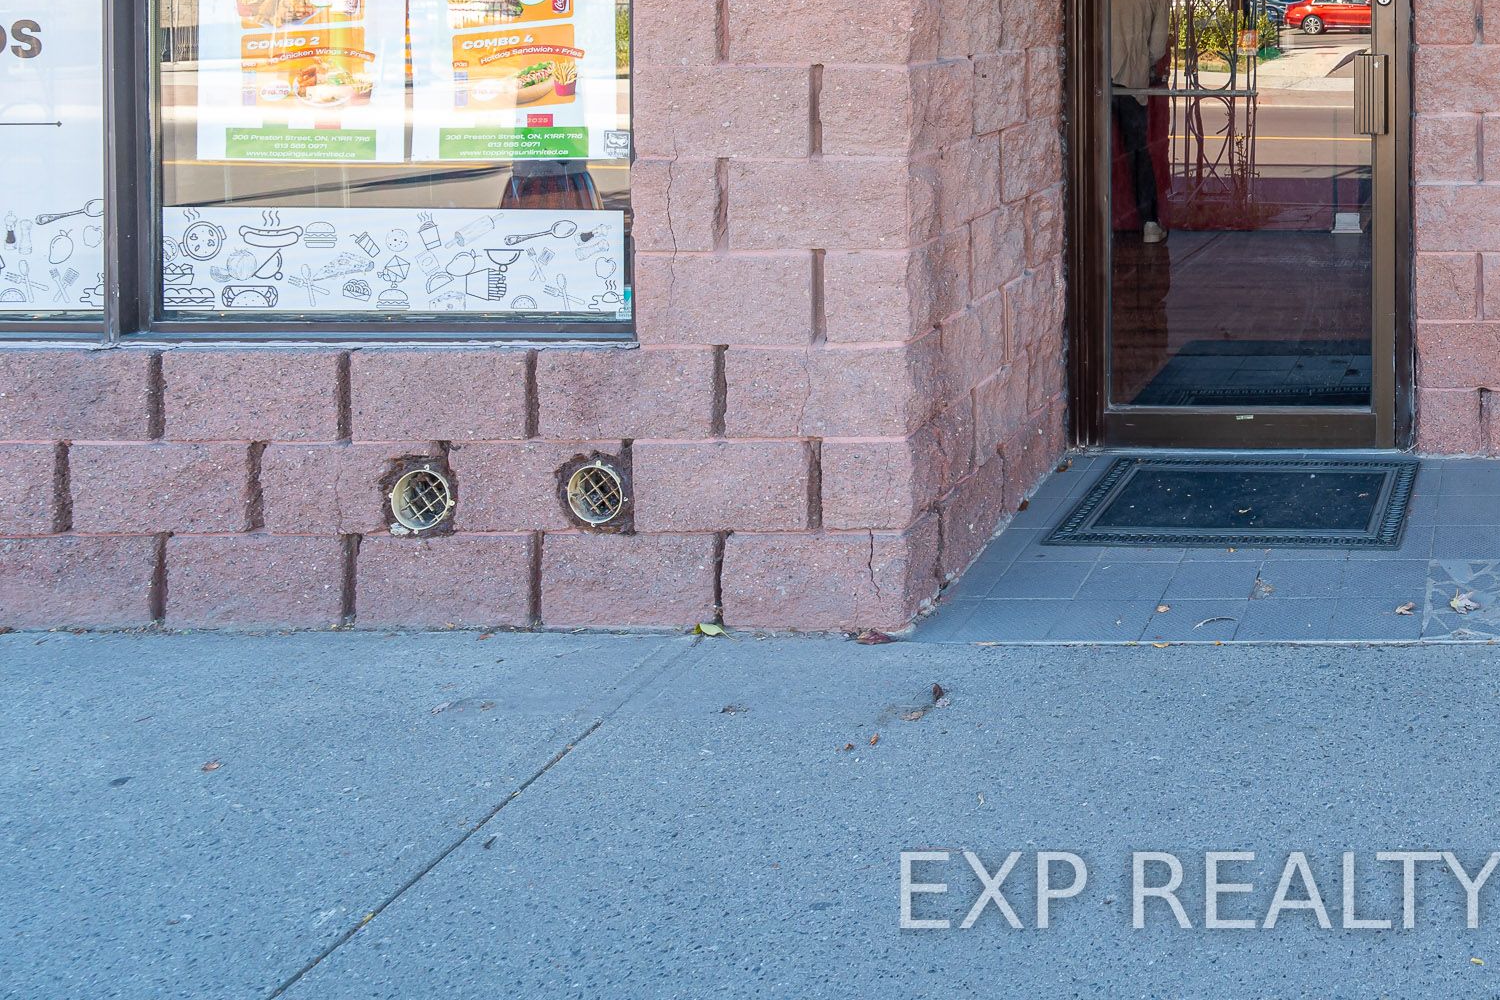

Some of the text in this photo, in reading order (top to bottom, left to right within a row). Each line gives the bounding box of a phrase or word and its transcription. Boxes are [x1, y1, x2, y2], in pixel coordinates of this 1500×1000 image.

[246, 36, 320, 50] COMBO 2
[462, 36, 520, 50] COMBO
[480, 52, 511, 65] Hotdog
[512, 46, 554, 56] Sandwich
[562, 48, 583, 58] Fries
